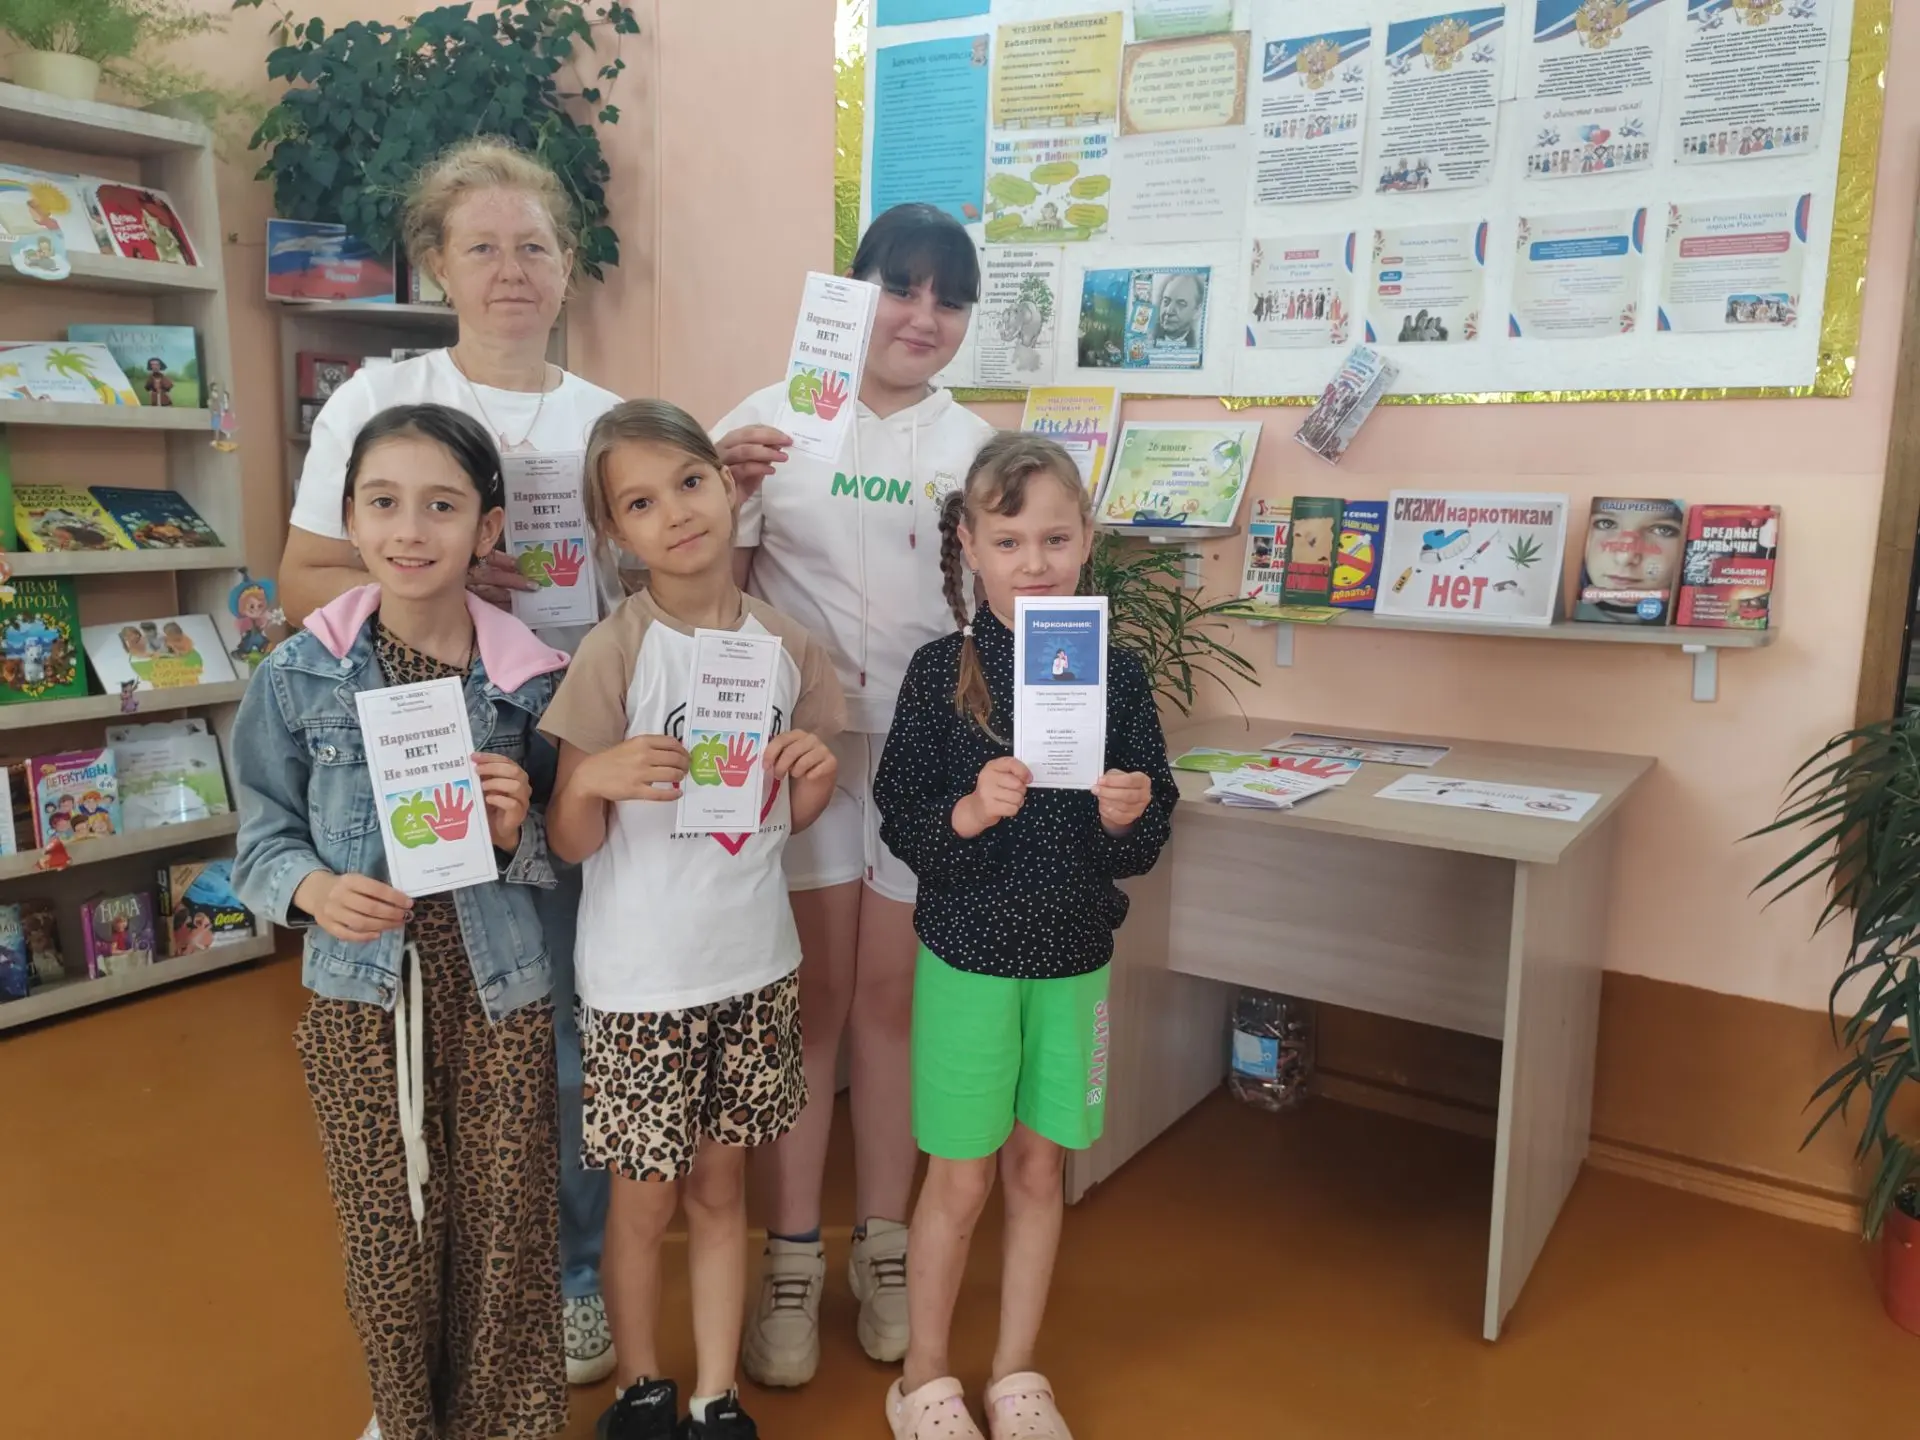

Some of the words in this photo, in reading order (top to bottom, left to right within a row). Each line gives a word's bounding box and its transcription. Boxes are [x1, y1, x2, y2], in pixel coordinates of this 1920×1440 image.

[1083, 134, 1107, 145] себя
[806, 311, 857, 331] Наркотики?
[816, 329, 839, 343] НЕТ!
[799, 341, 810, 353] Не
[812, 346, 827, 357] моя
[829, 349, 853, 362] тема!
[1148, 442, 1158, 451] 26
[1160, 444, 1187, 452] июня
[513, 489, 578, 503] Наркотики?
[532, 504, 561, 516] НЕТ!
[1602, 501, 1627, 511] ВАШ
[1349, 511, 1379, 519] семье
[1447, 503, 1554, 528] наркотикам
[514, 520, 529, 531] Не
[531, 521, 551, 530] моя
[554, 518, 581, 529] тема!
[1703, 526, 1759, 539] ВРЕДНЫЕ
[1692, 539, 1757, 553] ПРИВЫЧКИ
[1246, 569, 1255, 581] ОТ
[1332, 585, 1372, 601] делать?
[1584, 591, 1598, 599] ОТ
[1032, 620, 1092, 629] Наркомания:
[702, 673, 766, 688] Наркотики?
[718, 691, 746, 703] НЕТ!
[696, 706, 711, 718] Не
[712, 710, 733, 719] моя
[735, 711, 763, 721] тема!
[379, 722, 457, 747] Наркотики?
[404, 743, 439, 760] НЕТ!
[384, 768, 402, 781] Не
[404, 765, 429, 777] моя
[432, 756, 465, 772] тема!
[46, 763, 108, 790] ДЕТЕКТИВЫ
[670, 832, 699, 840] HAVE
